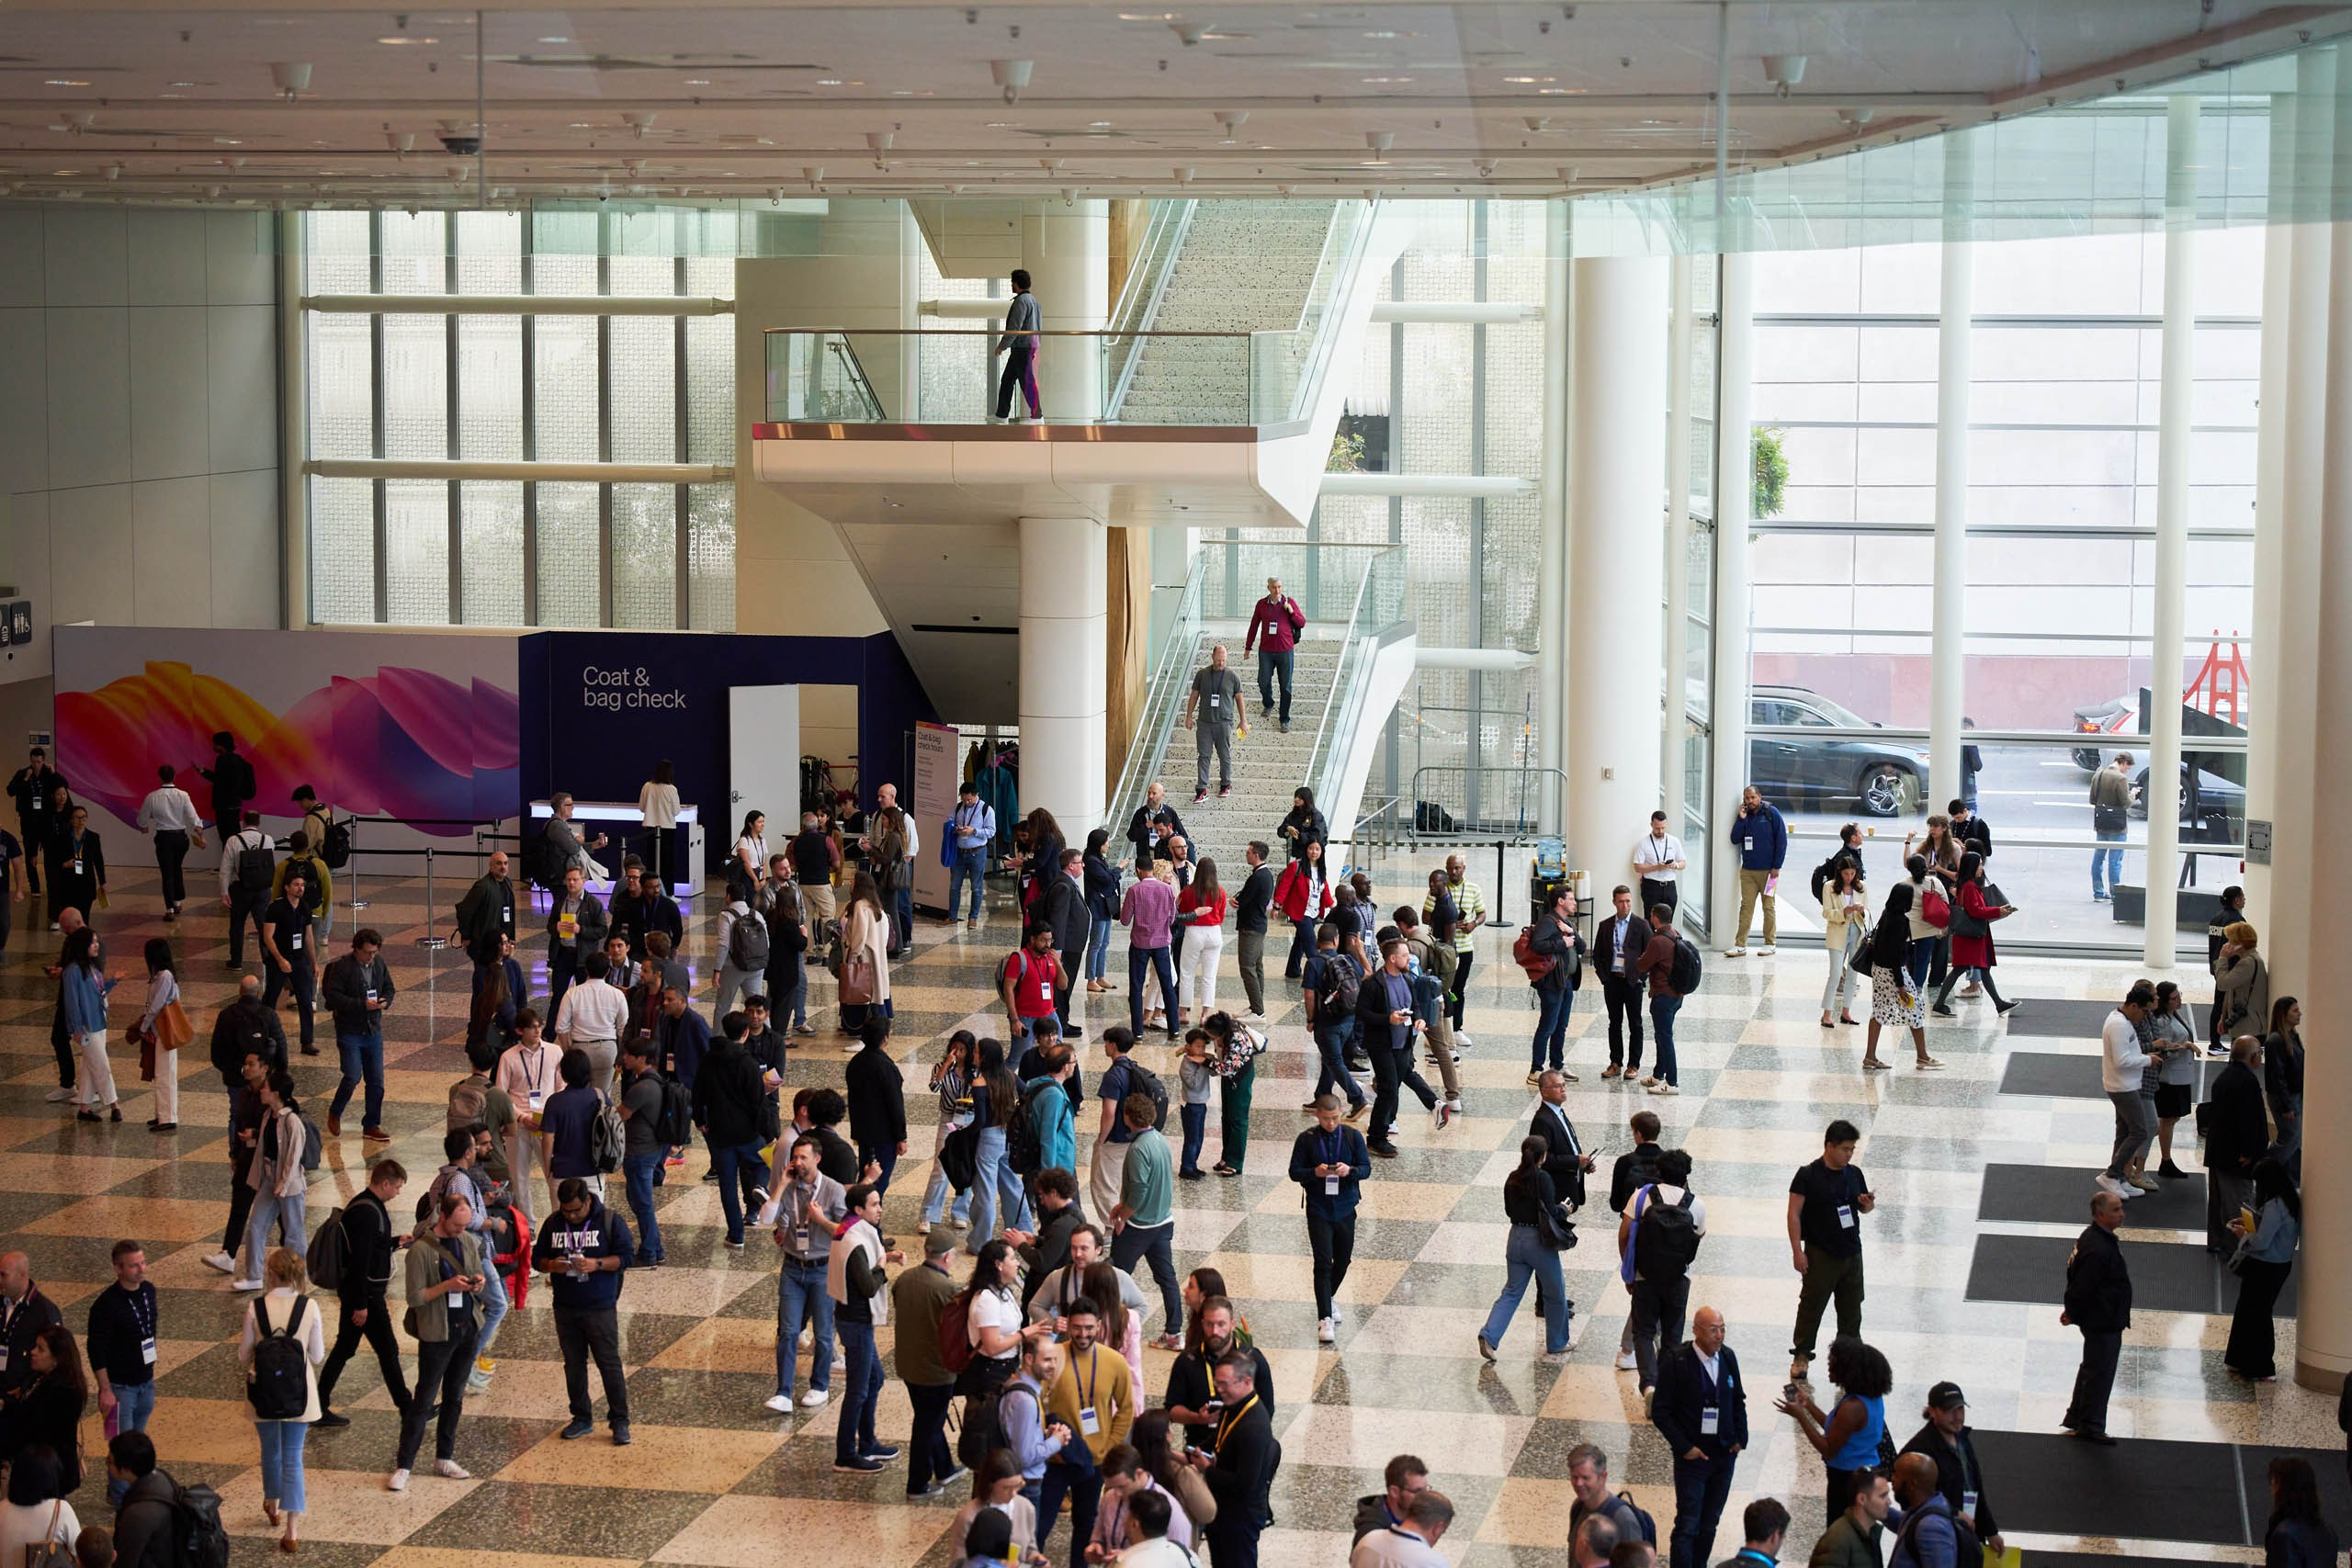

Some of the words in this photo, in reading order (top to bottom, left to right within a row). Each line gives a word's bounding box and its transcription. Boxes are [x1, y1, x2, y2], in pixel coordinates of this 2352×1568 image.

[583, 666, 630, 686] Coat
[634, 667, 650, 687] &
[584, 687, 621, 712] bag
[626, 688, 687, 708] check
